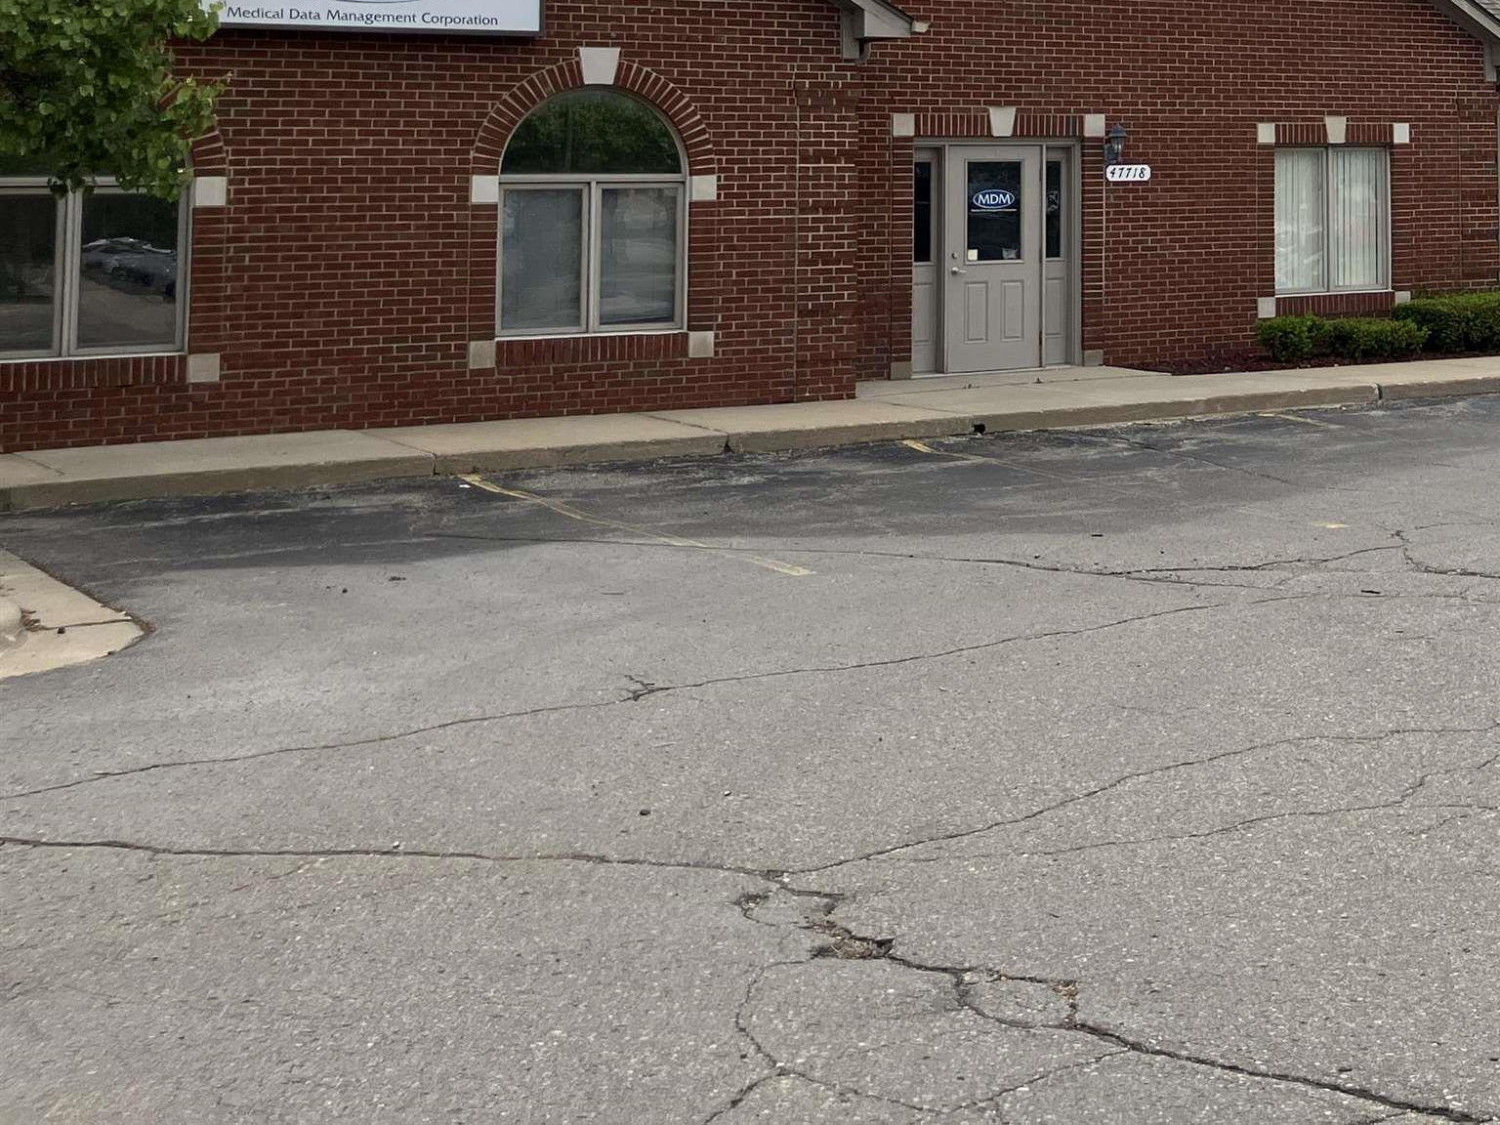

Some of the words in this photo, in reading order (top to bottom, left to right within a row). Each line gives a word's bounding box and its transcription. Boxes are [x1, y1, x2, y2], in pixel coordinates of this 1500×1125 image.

[226, 6, 285, 20] Medical
[288, 8, 321, 21] Data
[326, 10, 417, 26] Management
[421, 12, 499, 27] Corporation
[1110, 167, 1146, 179] 47718
[978, 193, 1011, 205] MDM
